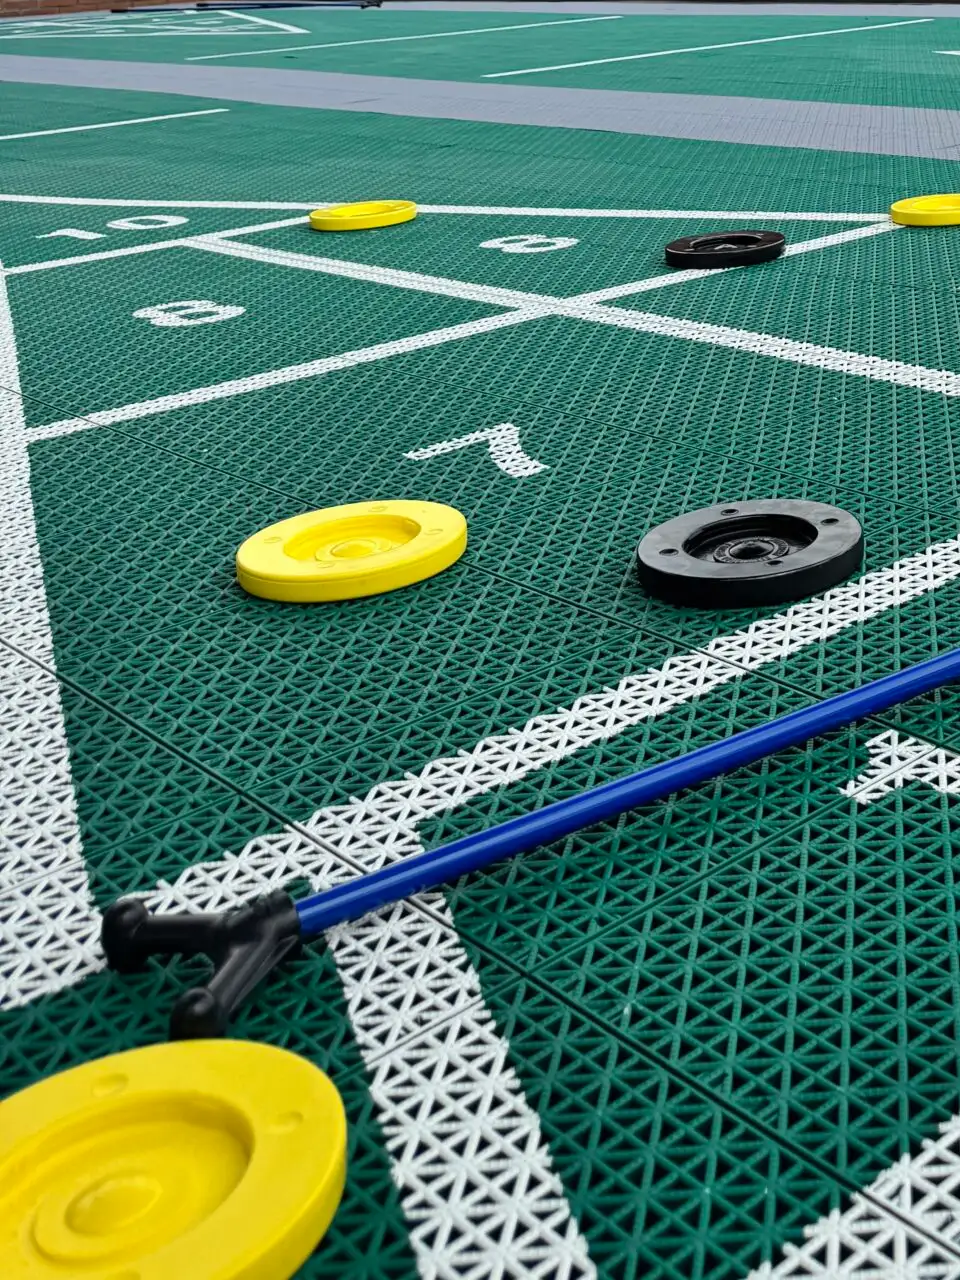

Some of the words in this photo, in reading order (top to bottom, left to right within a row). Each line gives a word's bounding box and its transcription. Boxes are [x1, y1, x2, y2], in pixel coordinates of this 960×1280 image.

[36, 214, 190, 240] 10
[479, 234, 579, 252] 8
[132, 300, 246, 329] 8
[402, 423, 550, 478] 7
